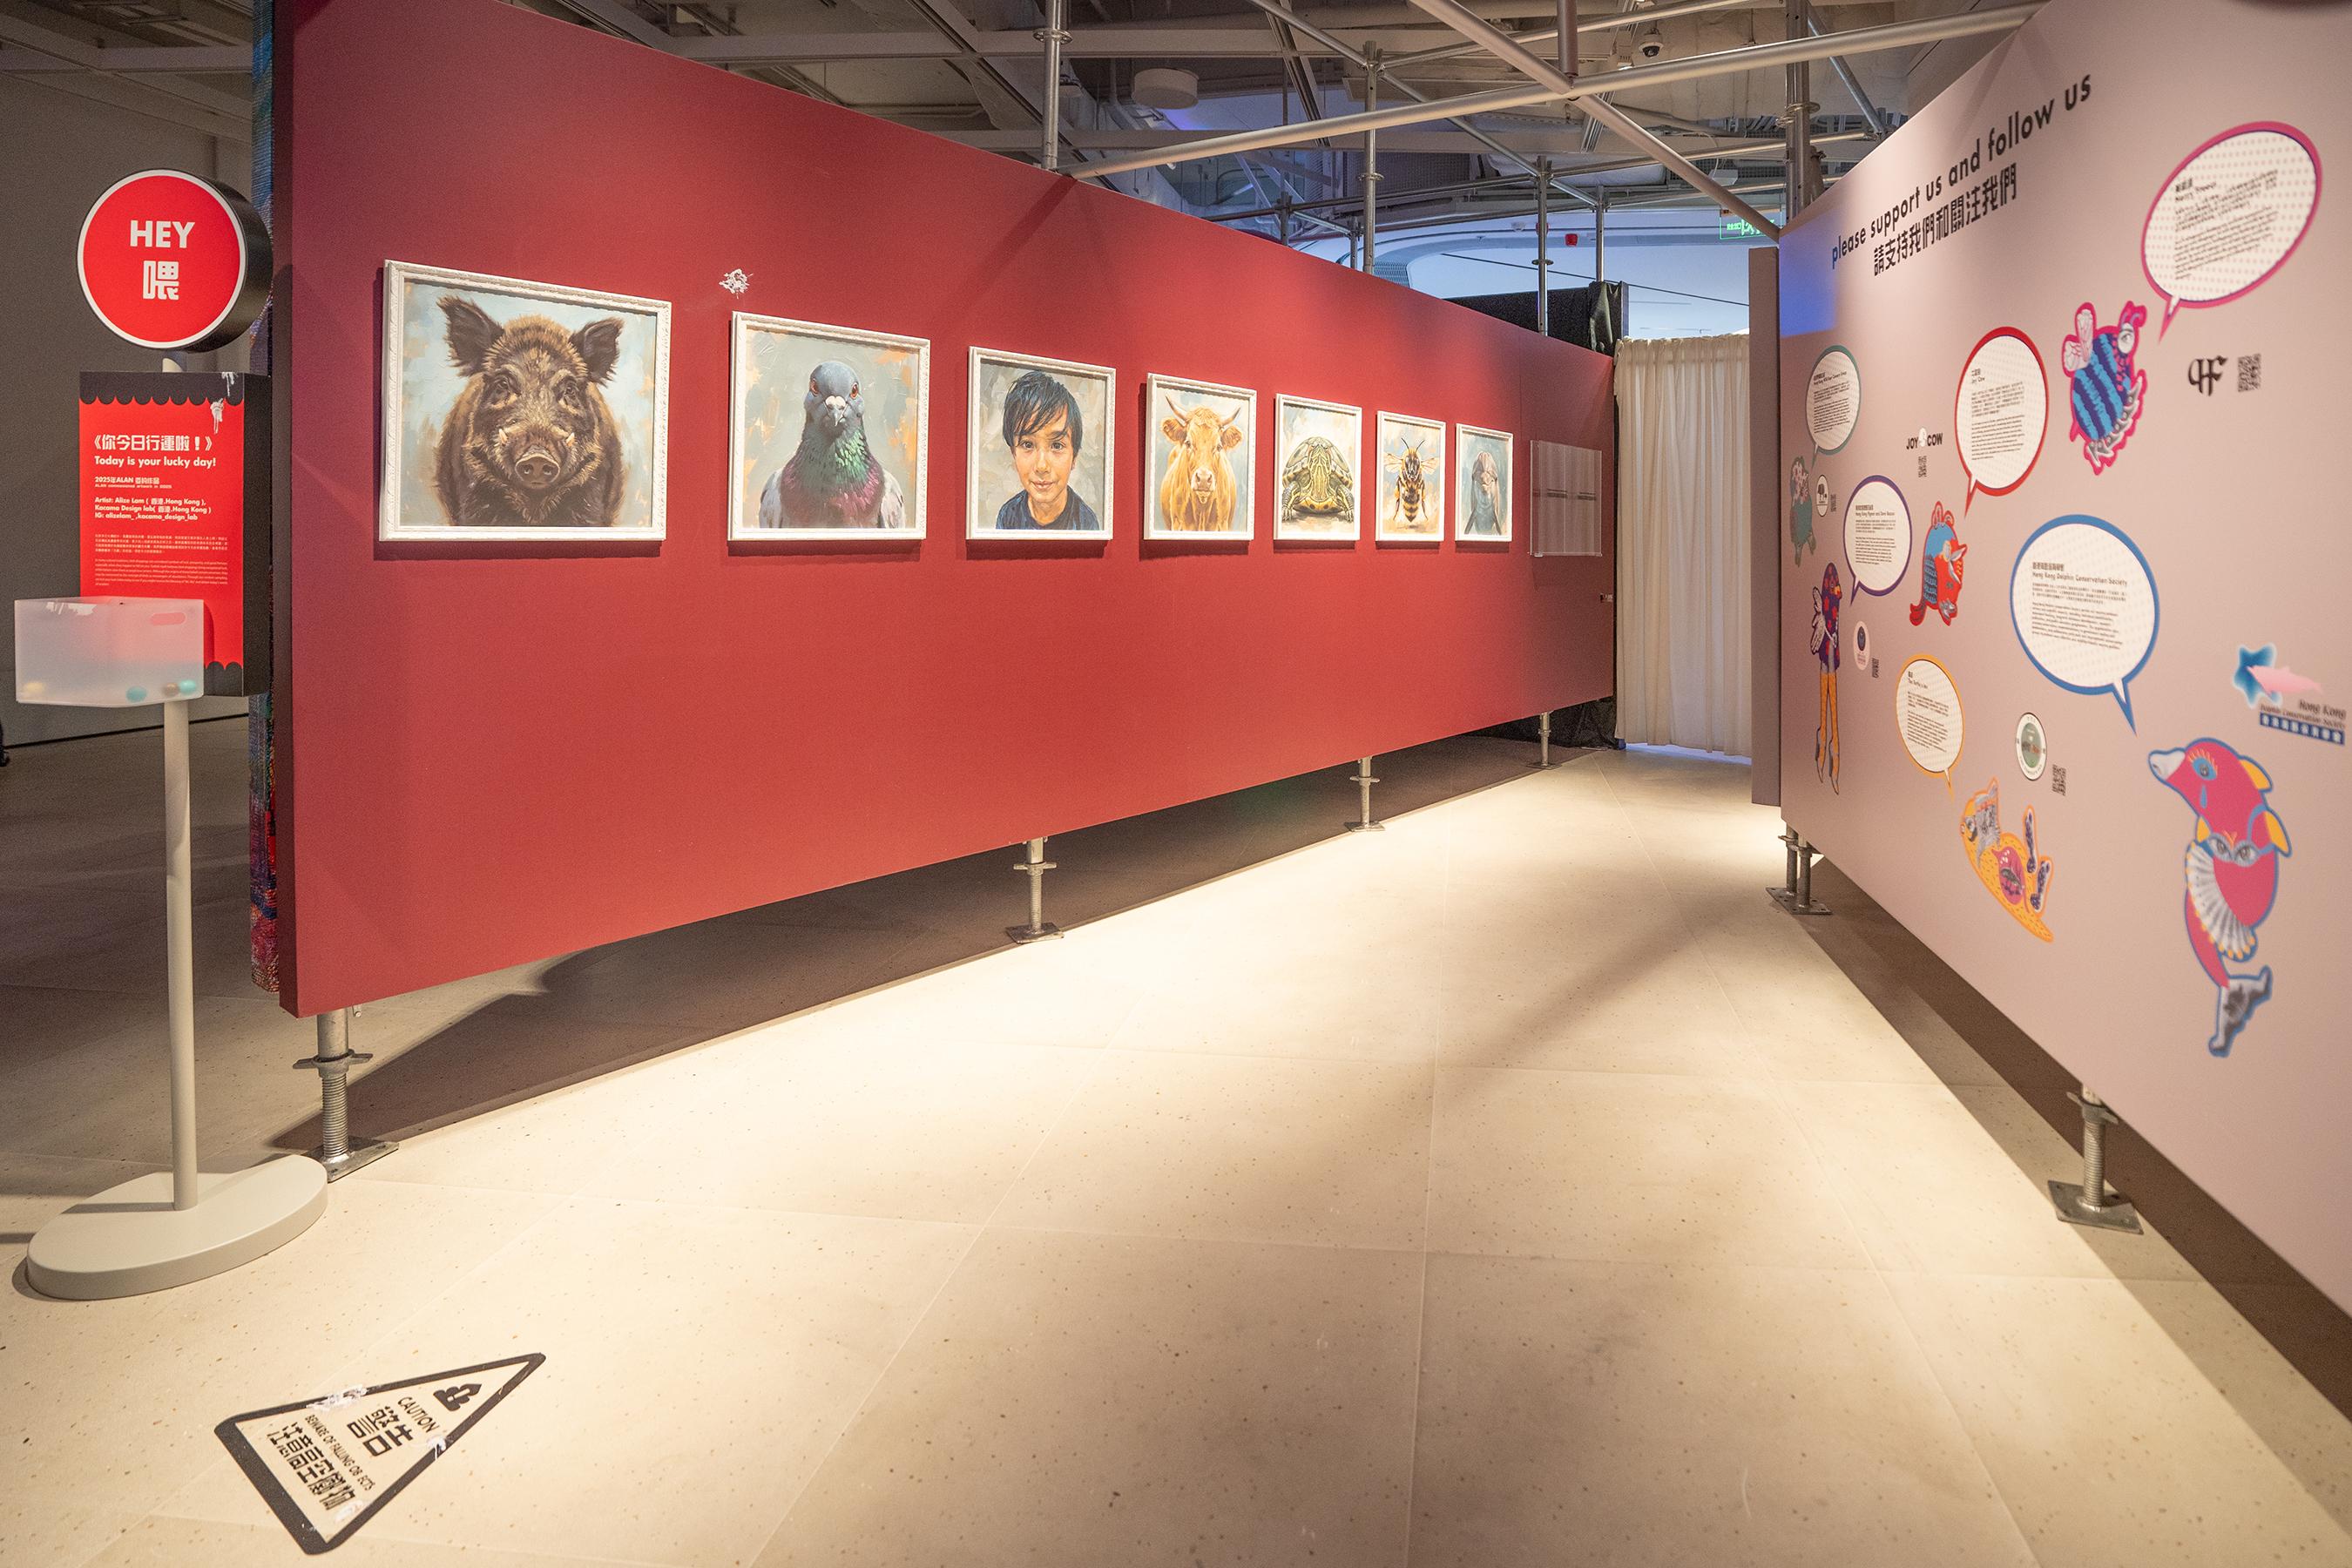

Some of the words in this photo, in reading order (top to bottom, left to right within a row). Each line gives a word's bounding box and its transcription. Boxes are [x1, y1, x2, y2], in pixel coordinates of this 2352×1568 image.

[1832, 226, 1866, 269] please
[1870, 186, 1920, 238] support
[1926, 176, 1942, 202] us
[1948, 139, 1980, 186] and
[1988, 98, 2054, 161] follow
[2065, 75, 2091, 111] us
[1874, 162, 2017, 276] 請支持我們和關注我們
[130, 220, 195, 249] HEY
[142, 260, 179, 301] 喂
[1906, 436, 1918, 449] JOY
[1927, 433, 1943, 447] COW
[94, 455, 125, 468] Today
[127, 456, 135, 465] is
[139, 458, 161, 468] your
[164, 456, 190, 469] lucky
[193, 456, 216, 469] day!
[2299, 699, 2321, 713] Hong
[2322, 704, 2347, 720] Kong
[305, 1415, 329, 1436] BEWARE
[397, 1396, 440, 1433] CAUTION
[323, 1435, 336, 1444] OF
[347, 1405, 414, 1456] 警告
[329, 1443, 355, 1466] FALLING
